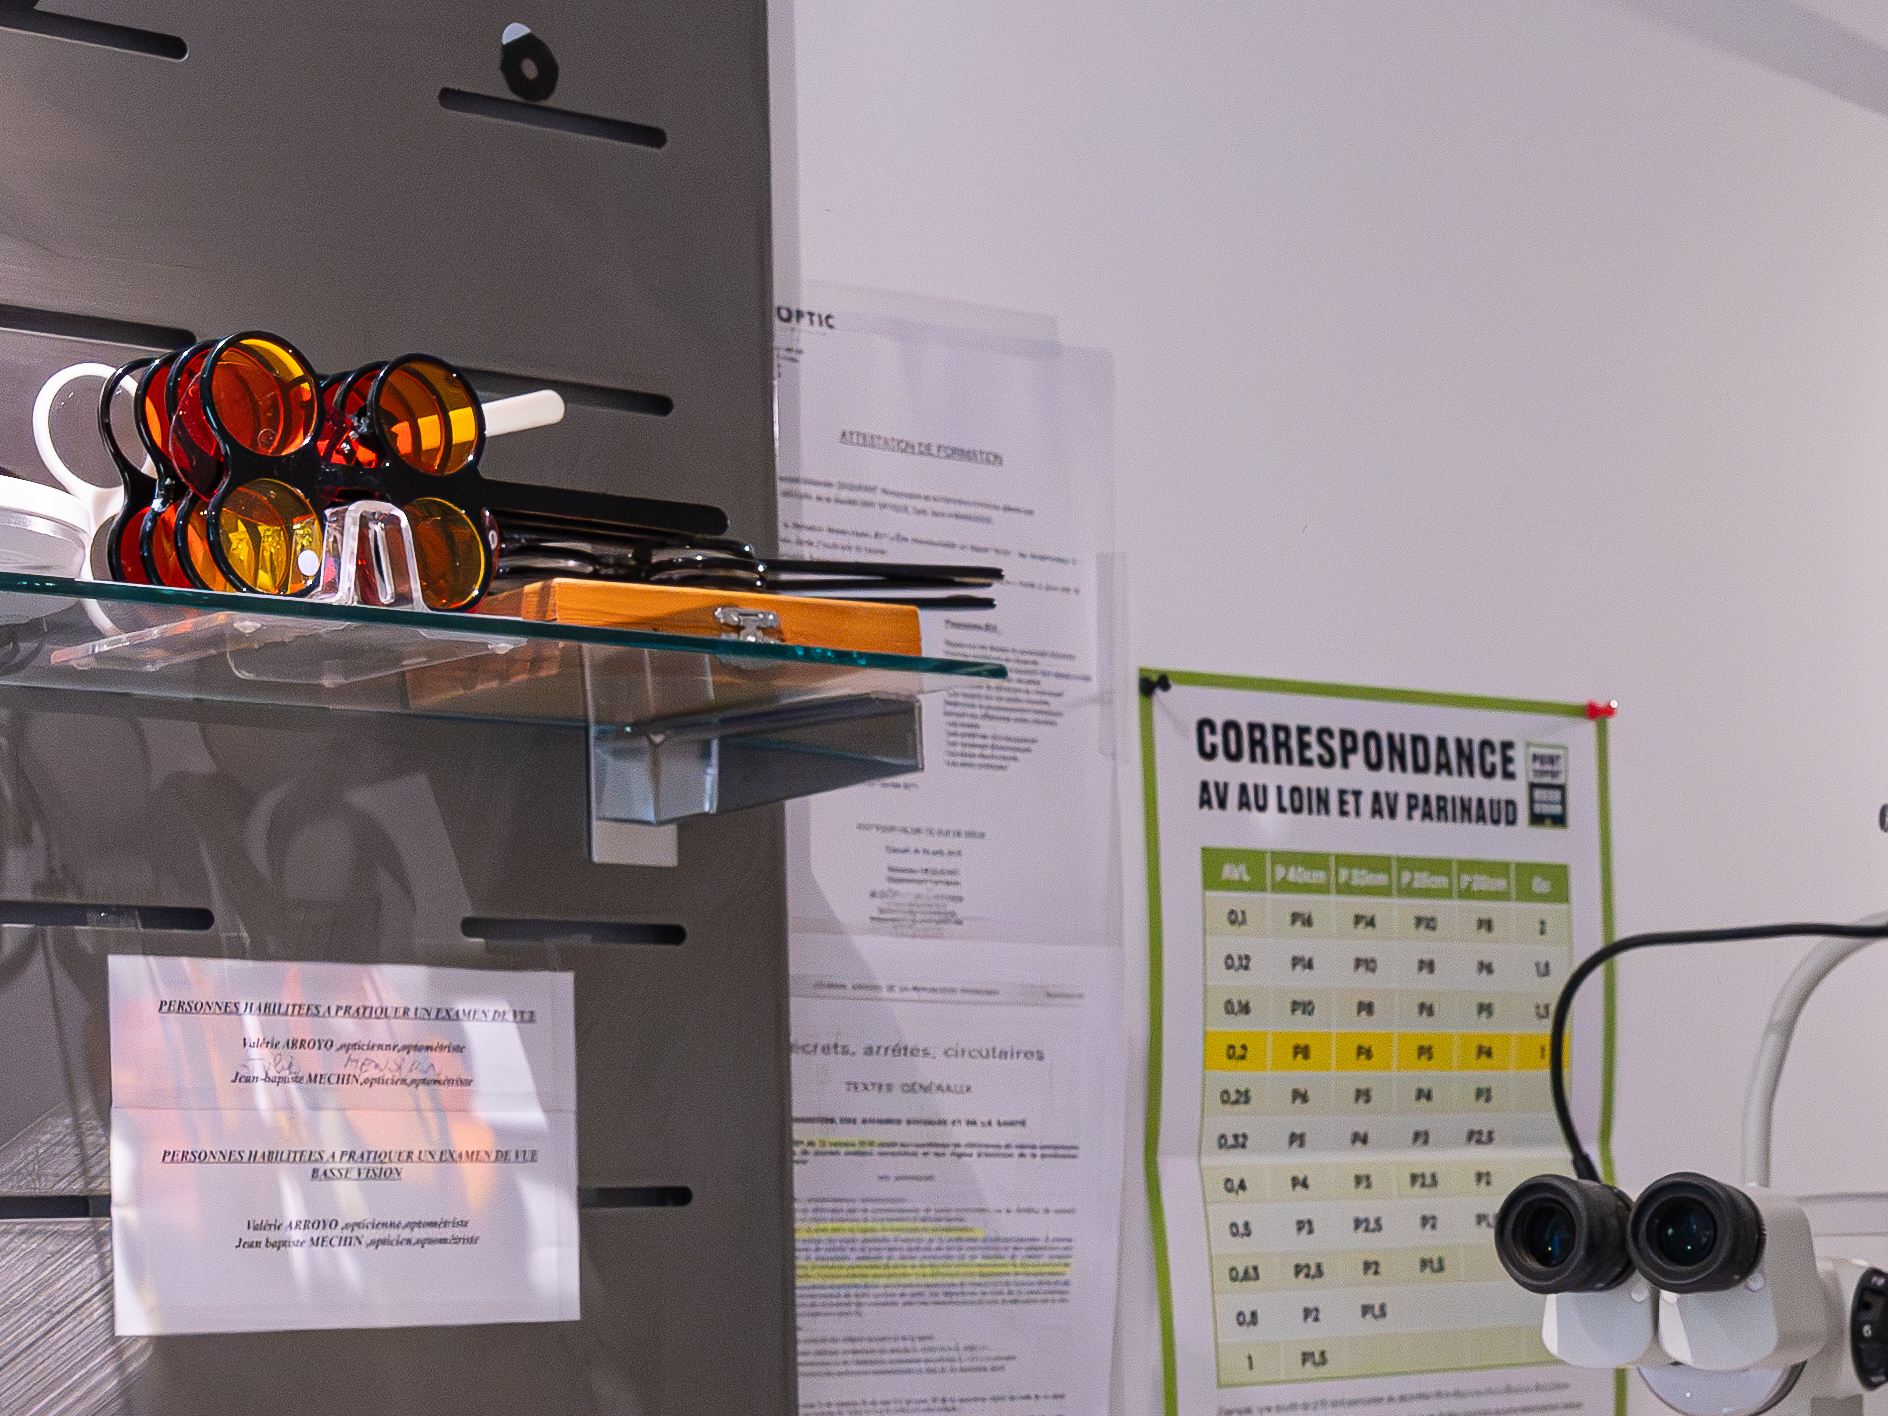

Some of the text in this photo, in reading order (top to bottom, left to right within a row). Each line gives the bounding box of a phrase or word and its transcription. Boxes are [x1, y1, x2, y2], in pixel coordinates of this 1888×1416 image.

[1196, 717, 1517, 781] CORRESPONDANCE
[1198, 780, 1518, 827] AV AU LOIN ET AV PARINAUD
[158, 1000, 240, 1016] PERSONNES
[243, 1001, 320, 1018] HABILITEES
[335, 1003, 411, 1020] PRATIQUER
[414, 1005, 433, 1021] UN
[434, 1006, 492, 1022] EXAMEN
[491, 1008, 511, 1023] DE
[243, 1037, 280, 1050] Valérie
[285, 1037, 334, 1051] ARROYO
[943, 1042, 1045, 1062] circulaires
[162, 1149, 245, 1165] PERSONNES
[249, 1149, 324, 1165] HABILITEES
[339, 1149, 414, 1165] PRATIQUER
[417, 1150, 436, 1165] UN
[438, 1149, 491, 1165] EXAMEN
[493, 1149, 512, 1164] DE
[513, 1149, 539, 1164] VUE
[311, 1167, 403, 1182] BASSE VISION
[246, 1218, 282, 1232] Valérie
[286, 1218, 339, 1231] ARROYO
[234, 1237, 262, 1249] Jean
[265, 1236, 306, 1251] baptiste
[308, 1235, 364, 1248] MECHIN
